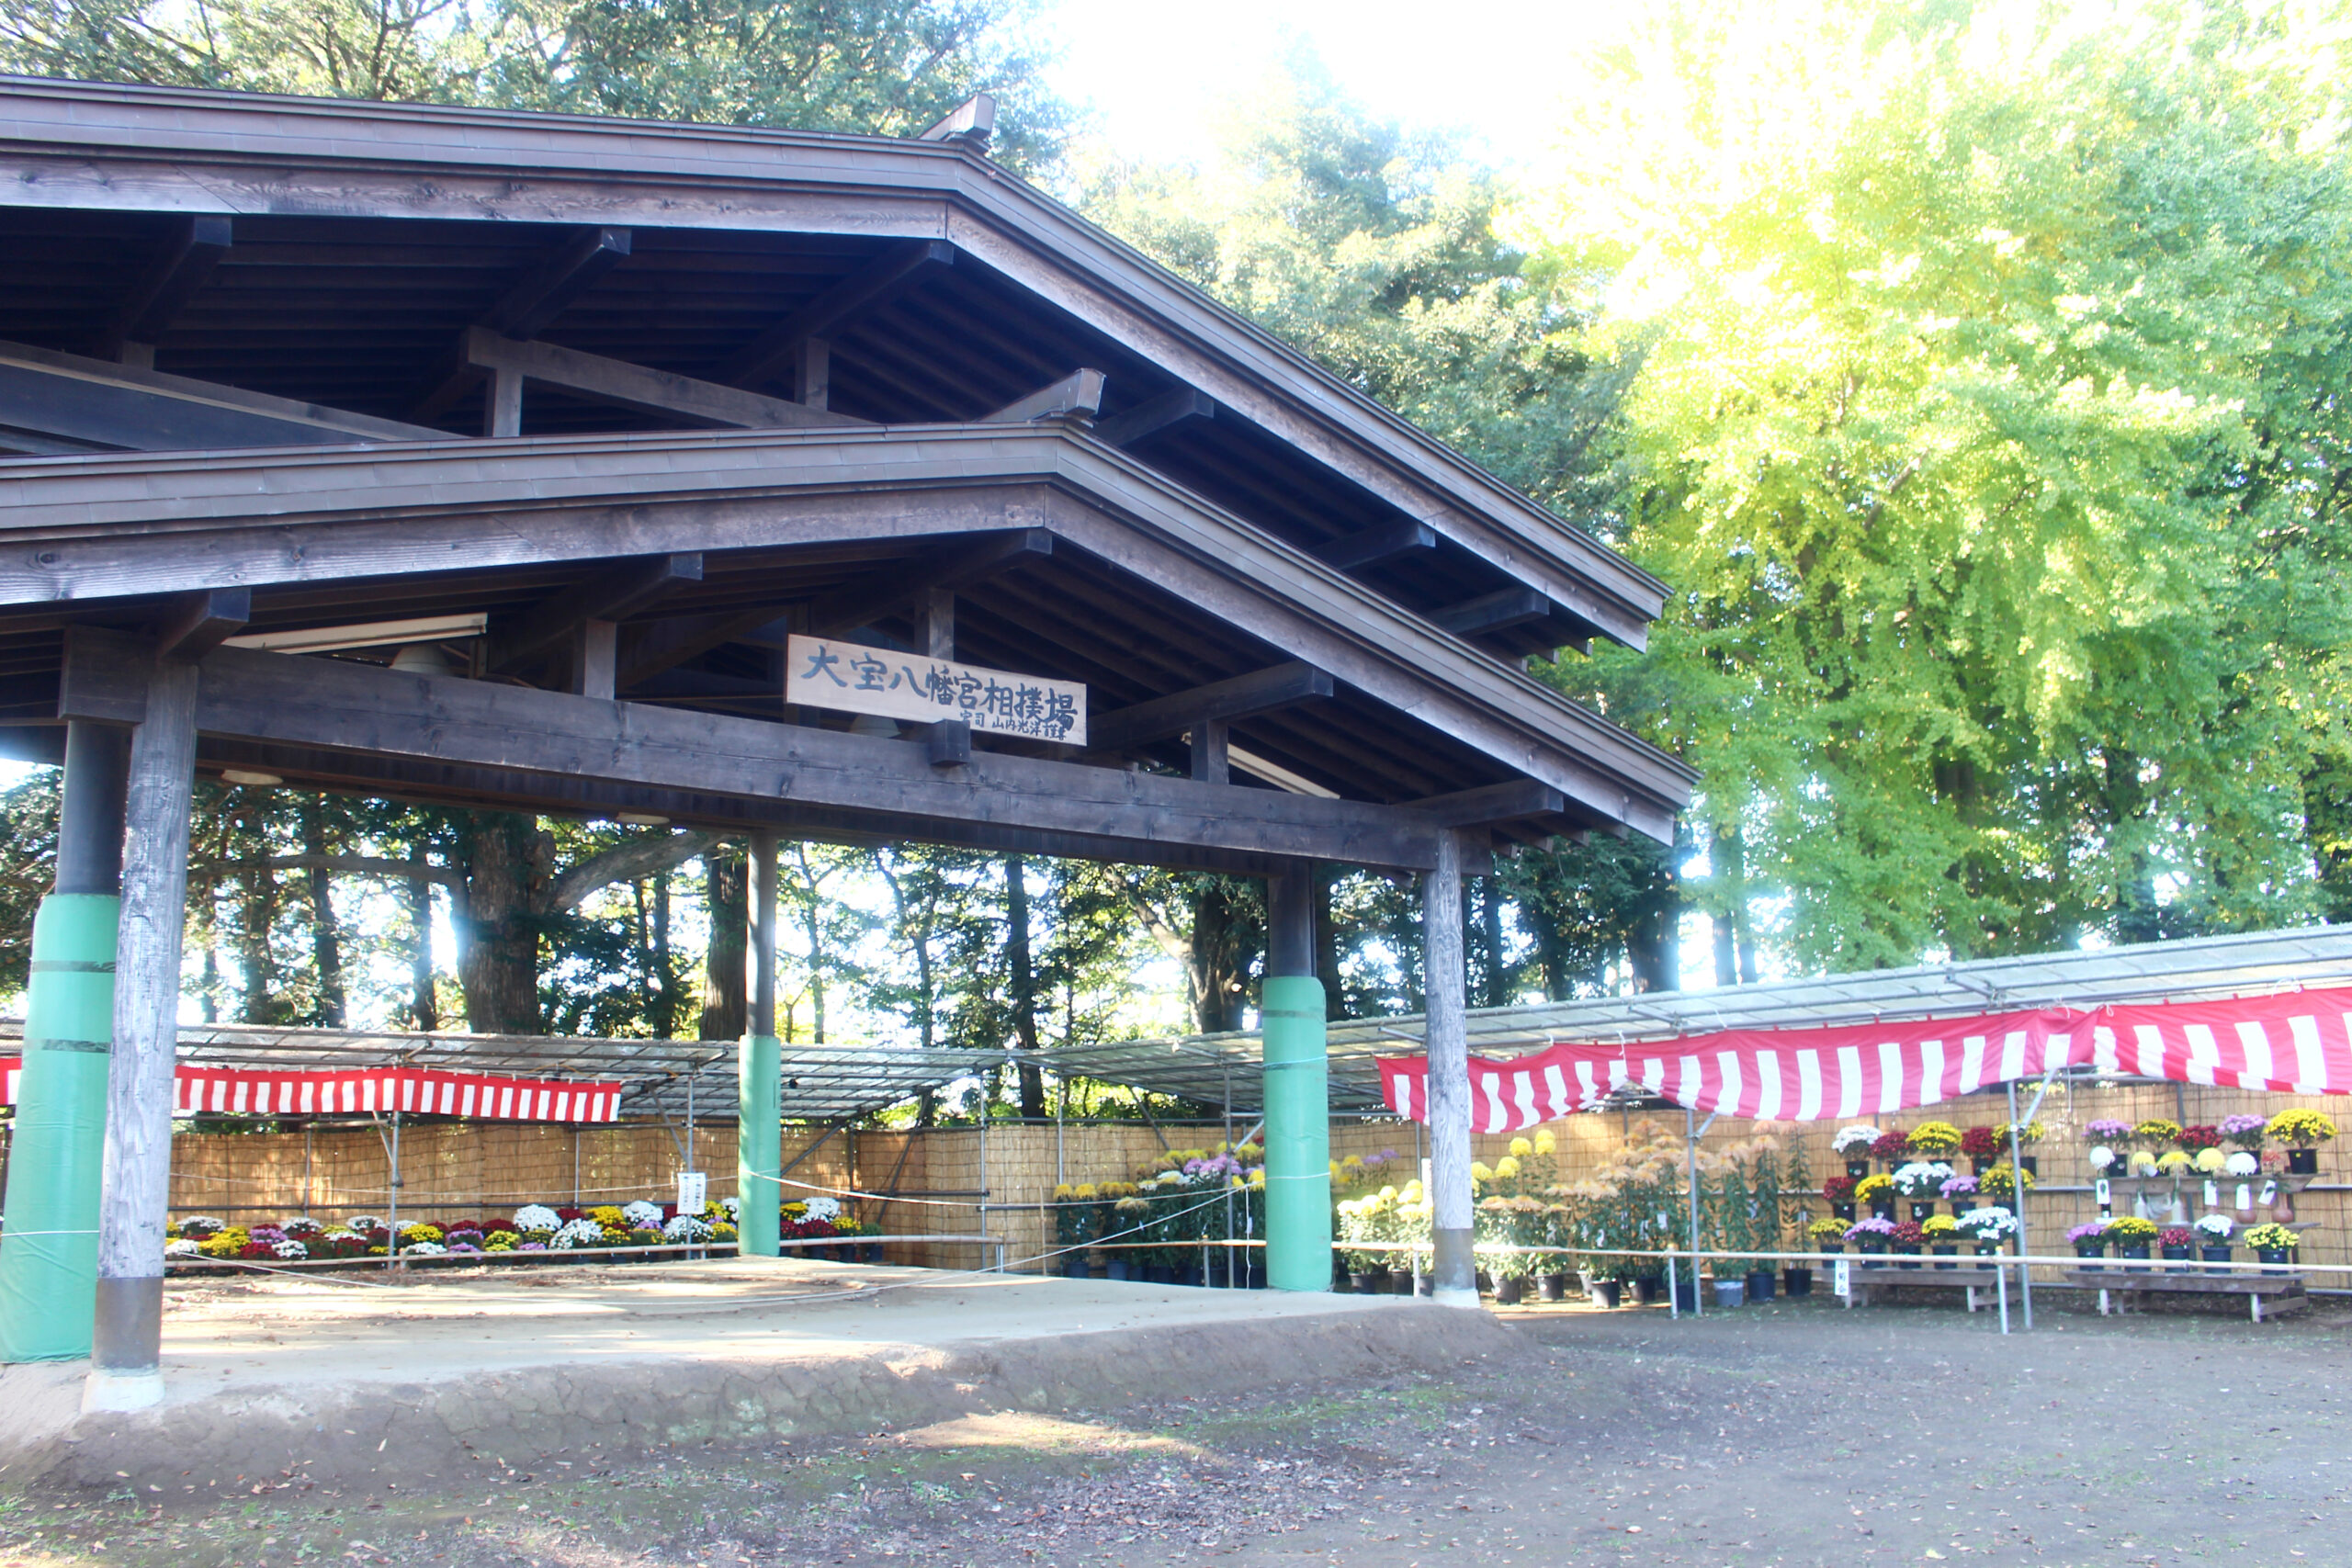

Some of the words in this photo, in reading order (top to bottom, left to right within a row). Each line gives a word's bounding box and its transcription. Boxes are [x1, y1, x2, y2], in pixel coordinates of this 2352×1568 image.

[800, 645, 1079, 731] 大宝八幡宮相撲場
